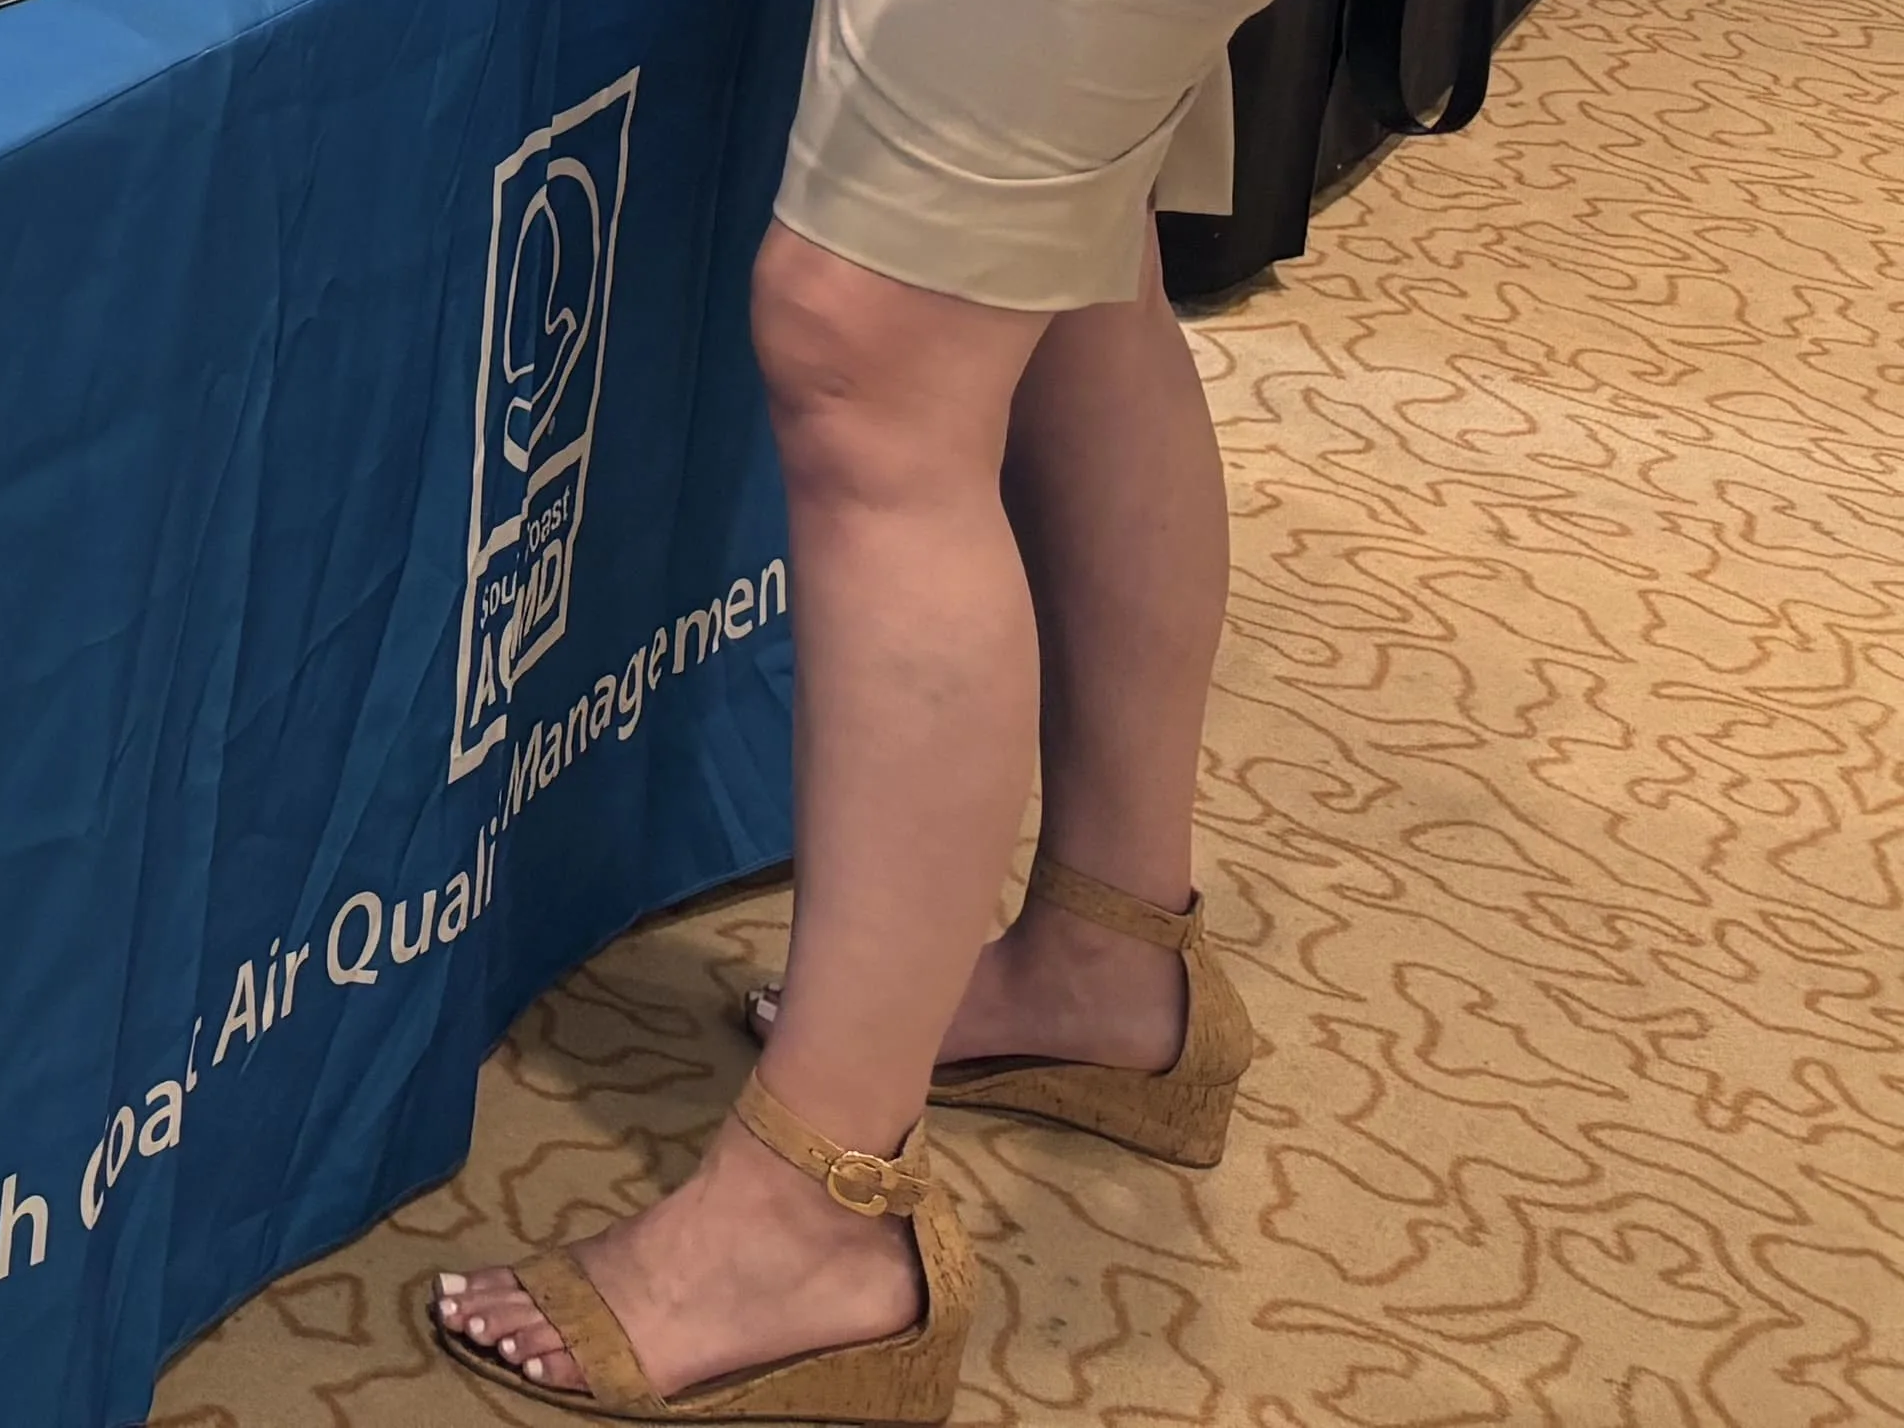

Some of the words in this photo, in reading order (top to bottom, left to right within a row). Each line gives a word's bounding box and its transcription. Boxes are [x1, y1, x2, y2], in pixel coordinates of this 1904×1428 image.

[211, 935, 311, 1069] Air
[325, 815, 499, 986] Quali
[501, 556, 789, 832] Managemen
